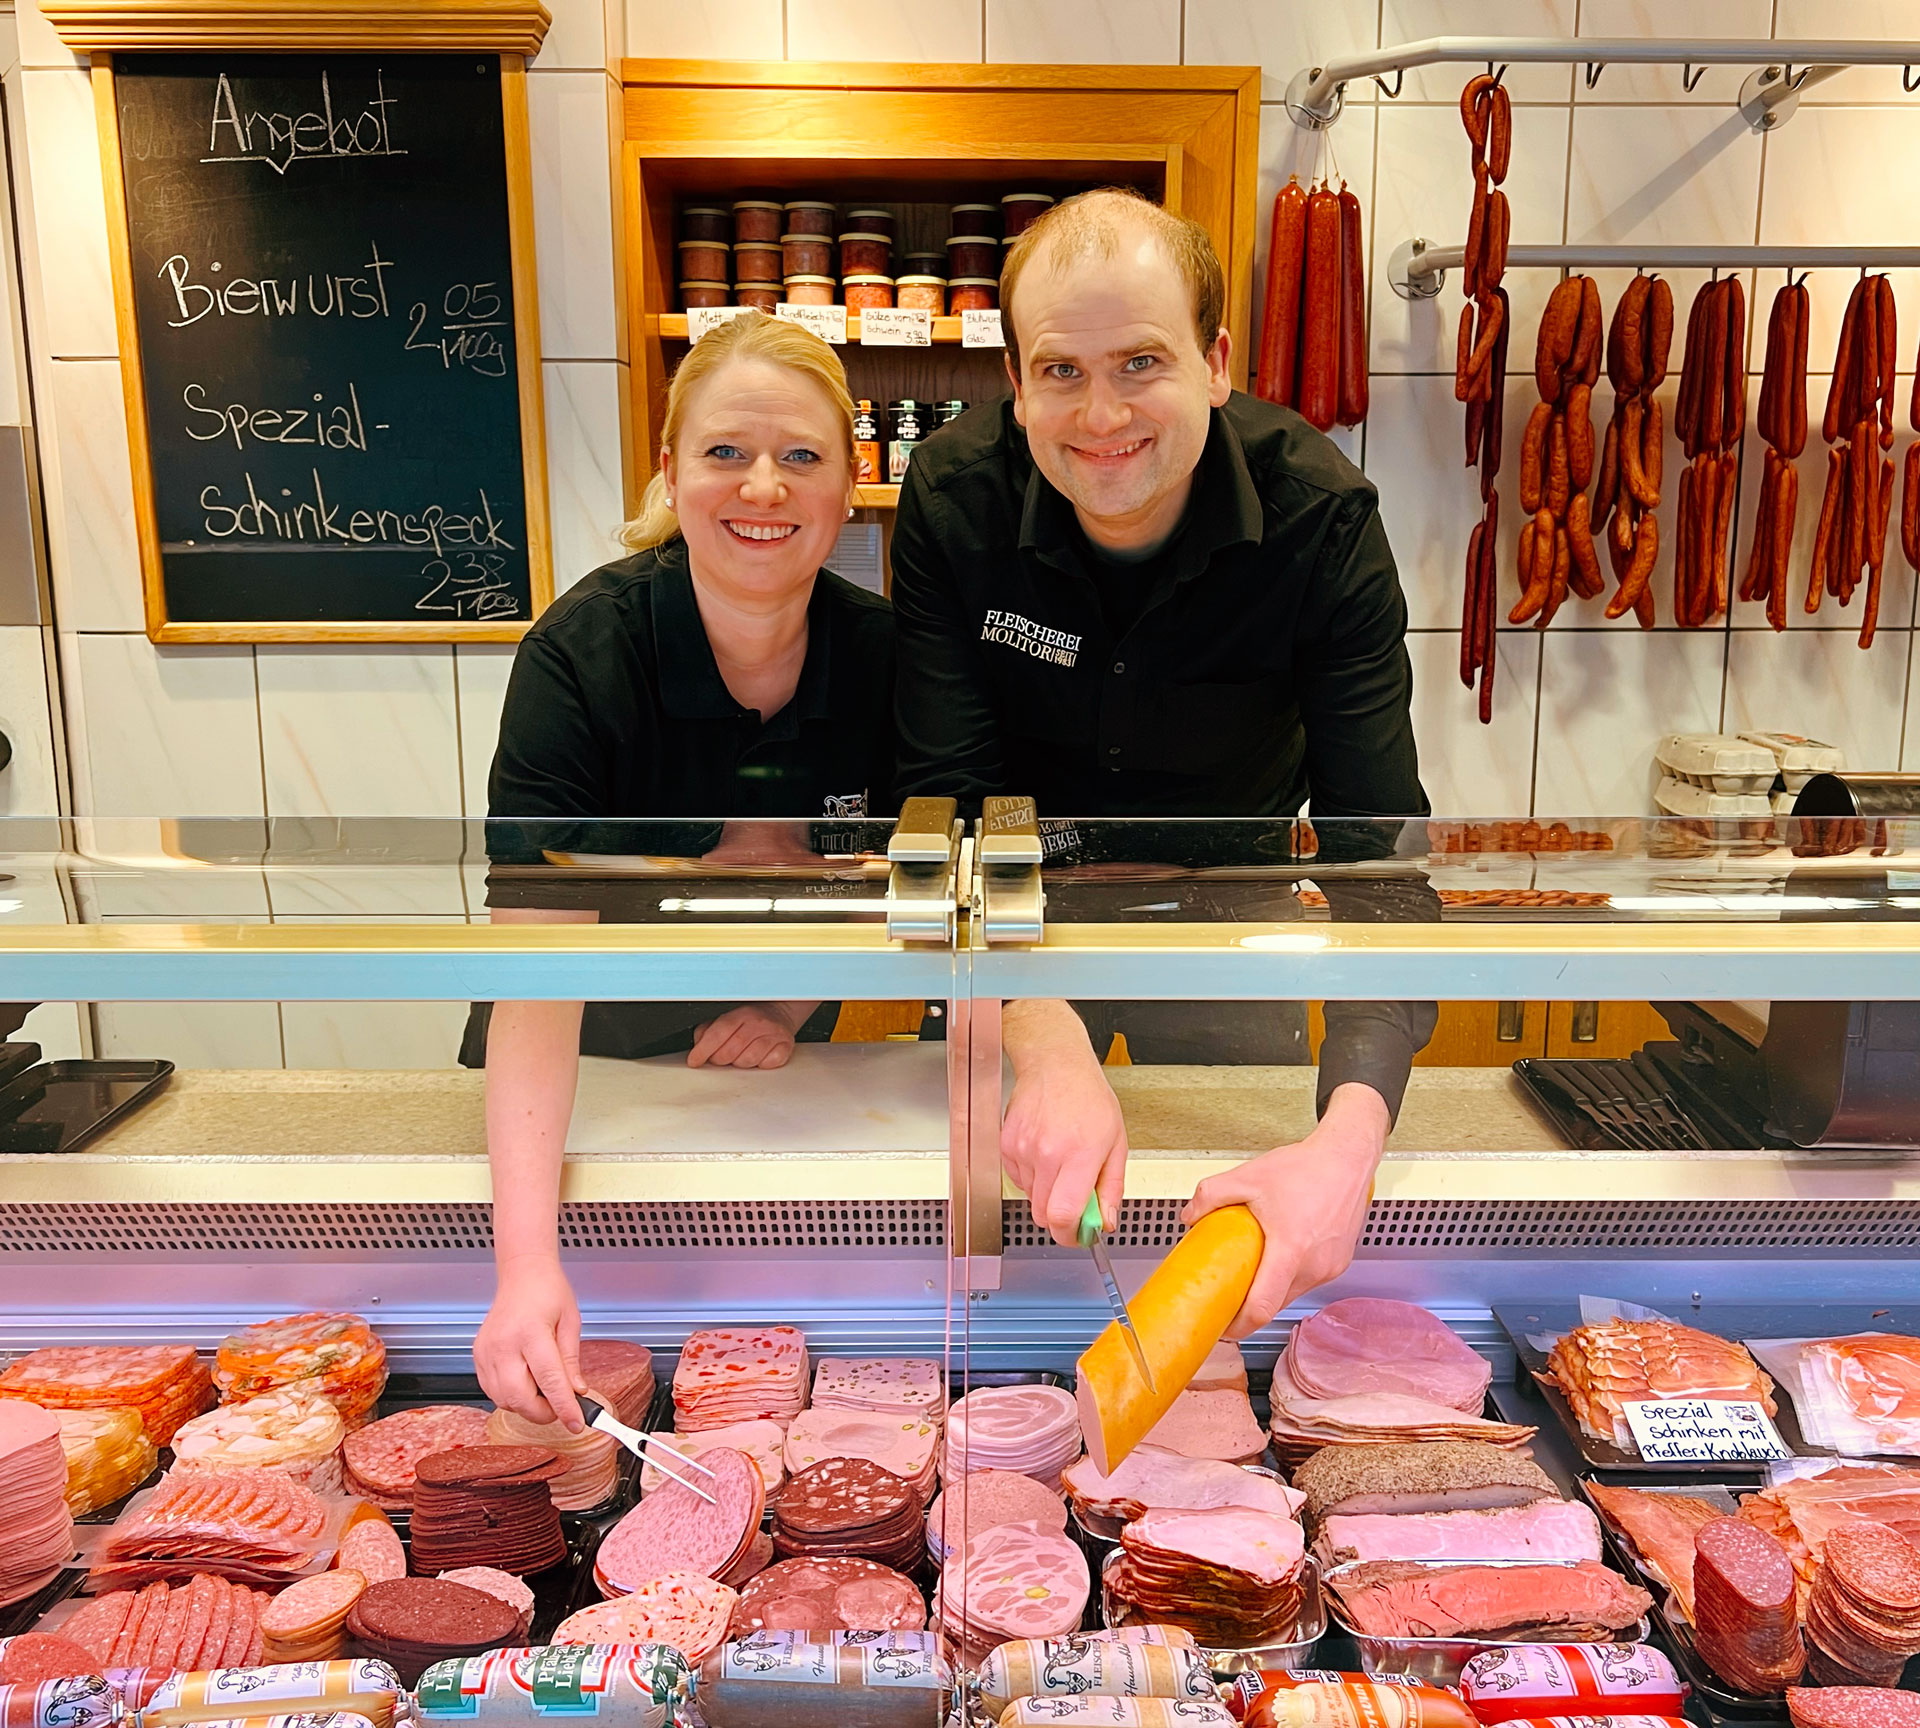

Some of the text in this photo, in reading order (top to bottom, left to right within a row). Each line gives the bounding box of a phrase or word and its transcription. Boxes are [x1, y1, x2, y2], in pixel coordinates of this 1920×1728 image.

[209, 69, 399, 173] Angebot
[158, 240, 396, 327] Bierwurst
[183, 383, 390, 451] Spezial-
[200, 467, 516, 557] Schinkenspeck
[980, 625, 1053, 662] MOLITOR
[984, 609, 1083, 652] FLEISCHEREI
[1640, 1401, 1713, 1419] Spezial
[1649, 1420, 1768, 1440] Schinken mit
